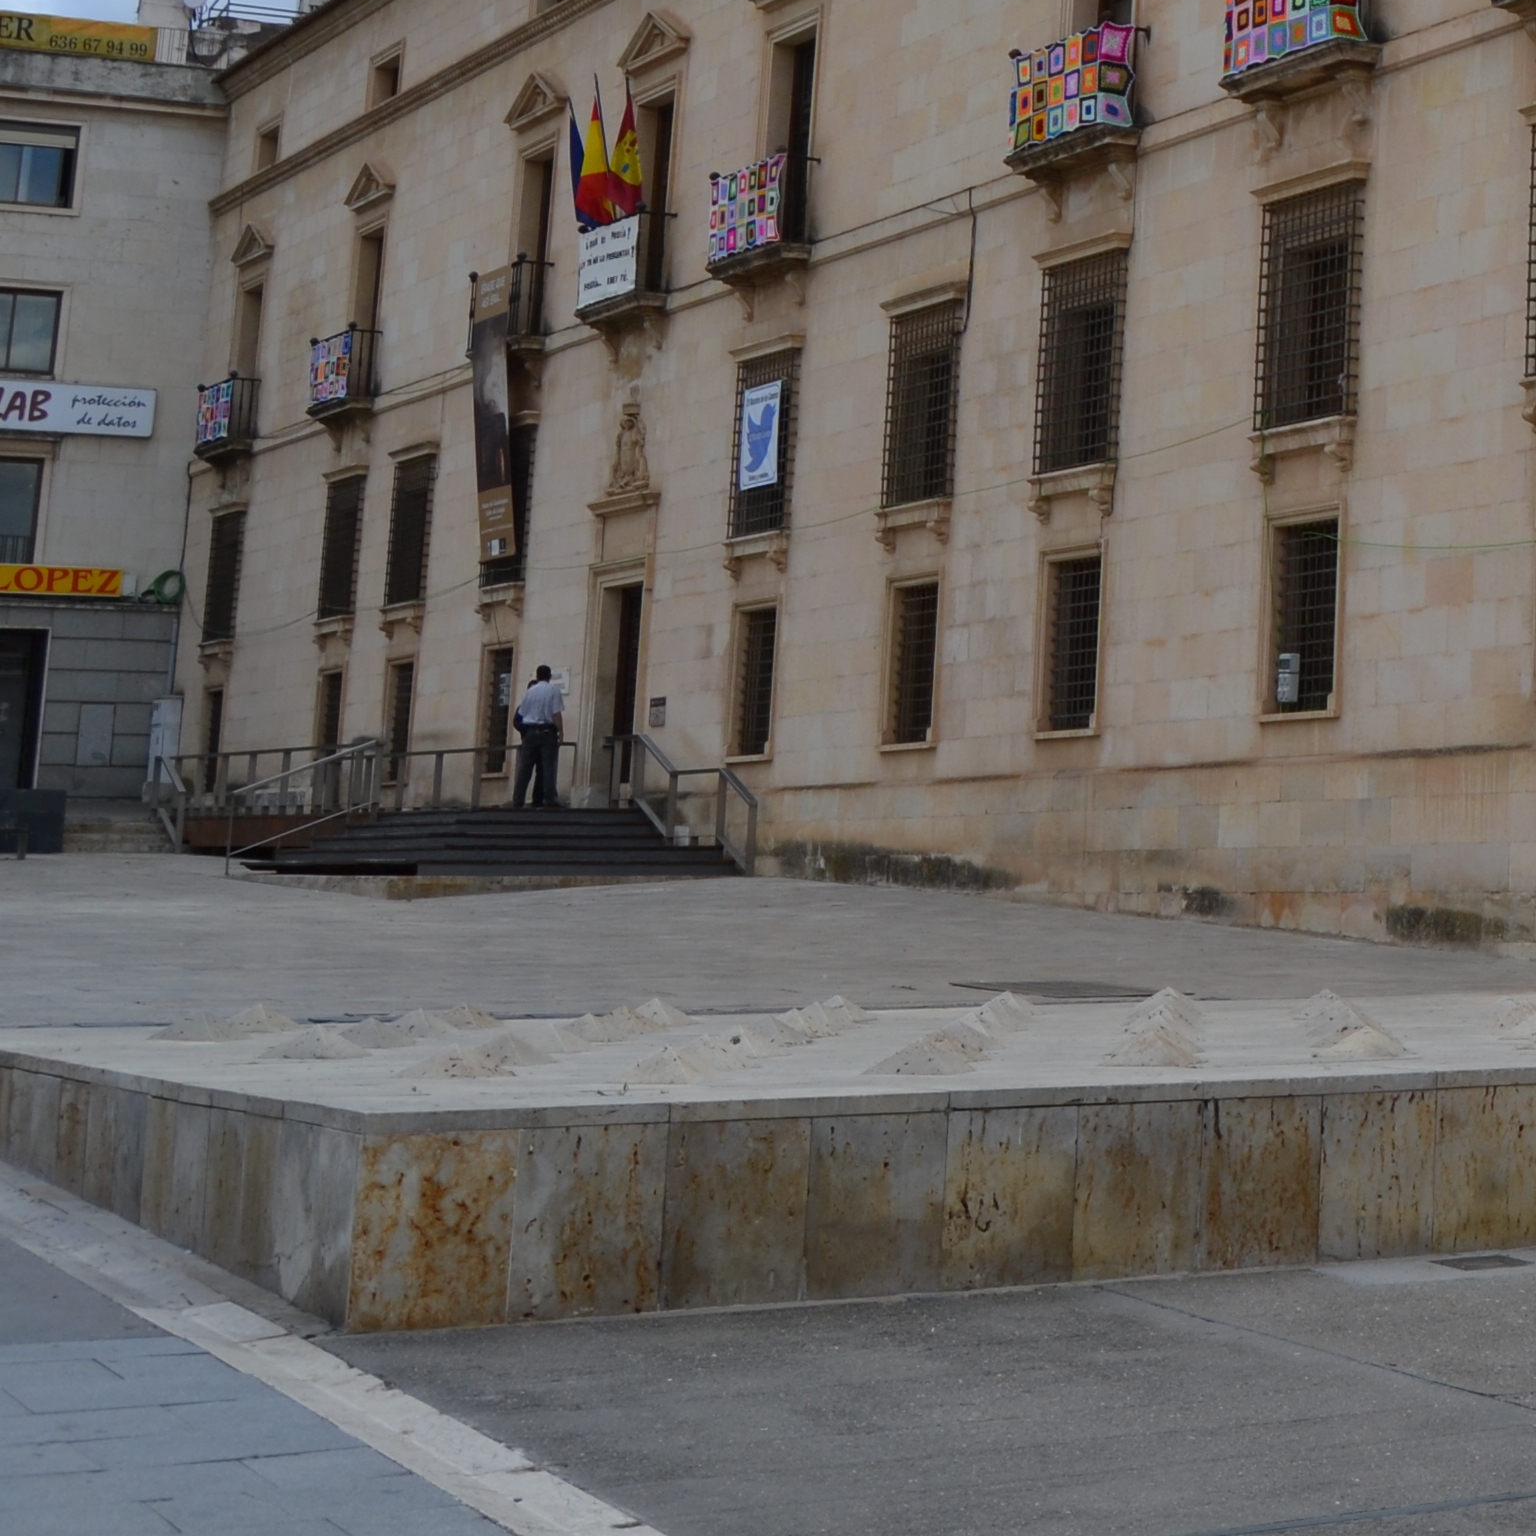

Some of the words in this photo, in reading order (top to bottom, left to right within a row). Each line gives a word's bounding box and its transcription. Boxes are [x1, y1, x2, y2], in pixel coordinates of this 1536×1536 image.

[50, 35, 77, 50] 636
[83, 38, 101, 52] 67
[106, 41, 123, 54] 94
[130, 43, 147, 56] 99
[71, 393, 146, 410] protección
[76, 412, 93, 426] de
[97, 413, 137, 429] datos
